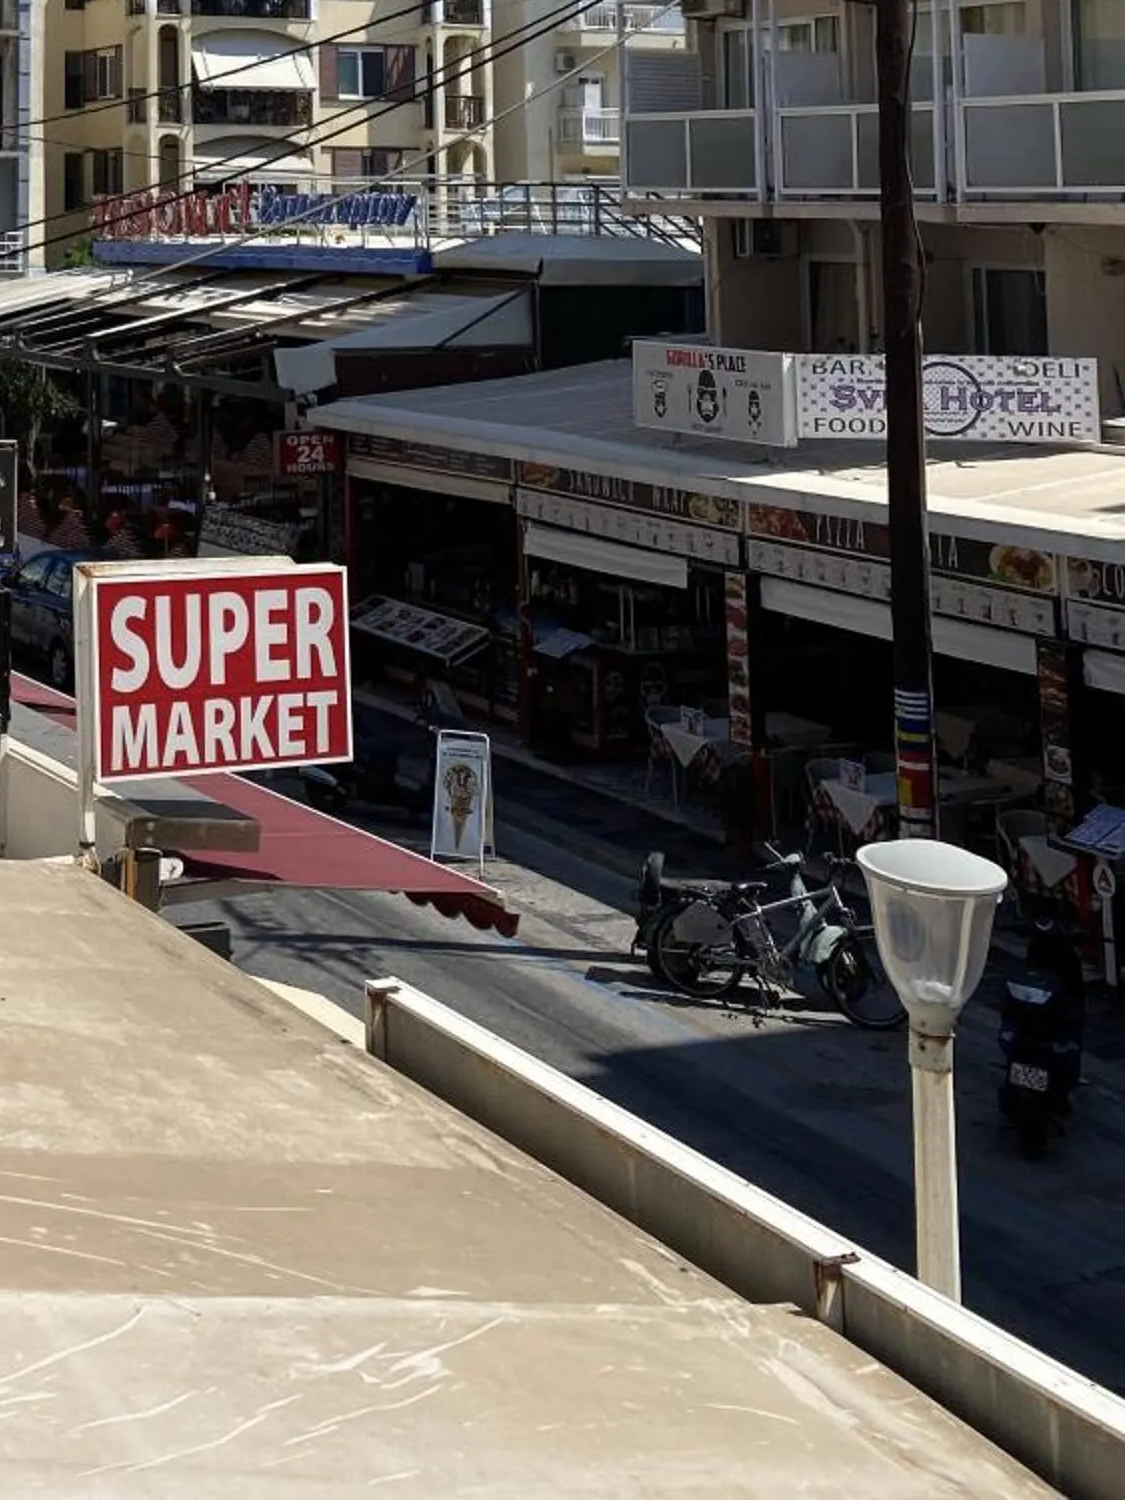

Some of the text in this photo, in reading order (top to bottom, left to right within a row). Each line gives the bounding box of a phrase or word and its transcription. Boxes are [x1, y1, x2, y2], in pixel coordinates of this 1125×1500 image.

[812, 359, 865, 375] BAR
[813, 417, 886, 433] FOOD
[286, 434, 334, 446] OPEN
[296, 445, 324, 463] 24
[109, 586, 338, 693] SUPER
[110, 690, 338, 772] MARKET
